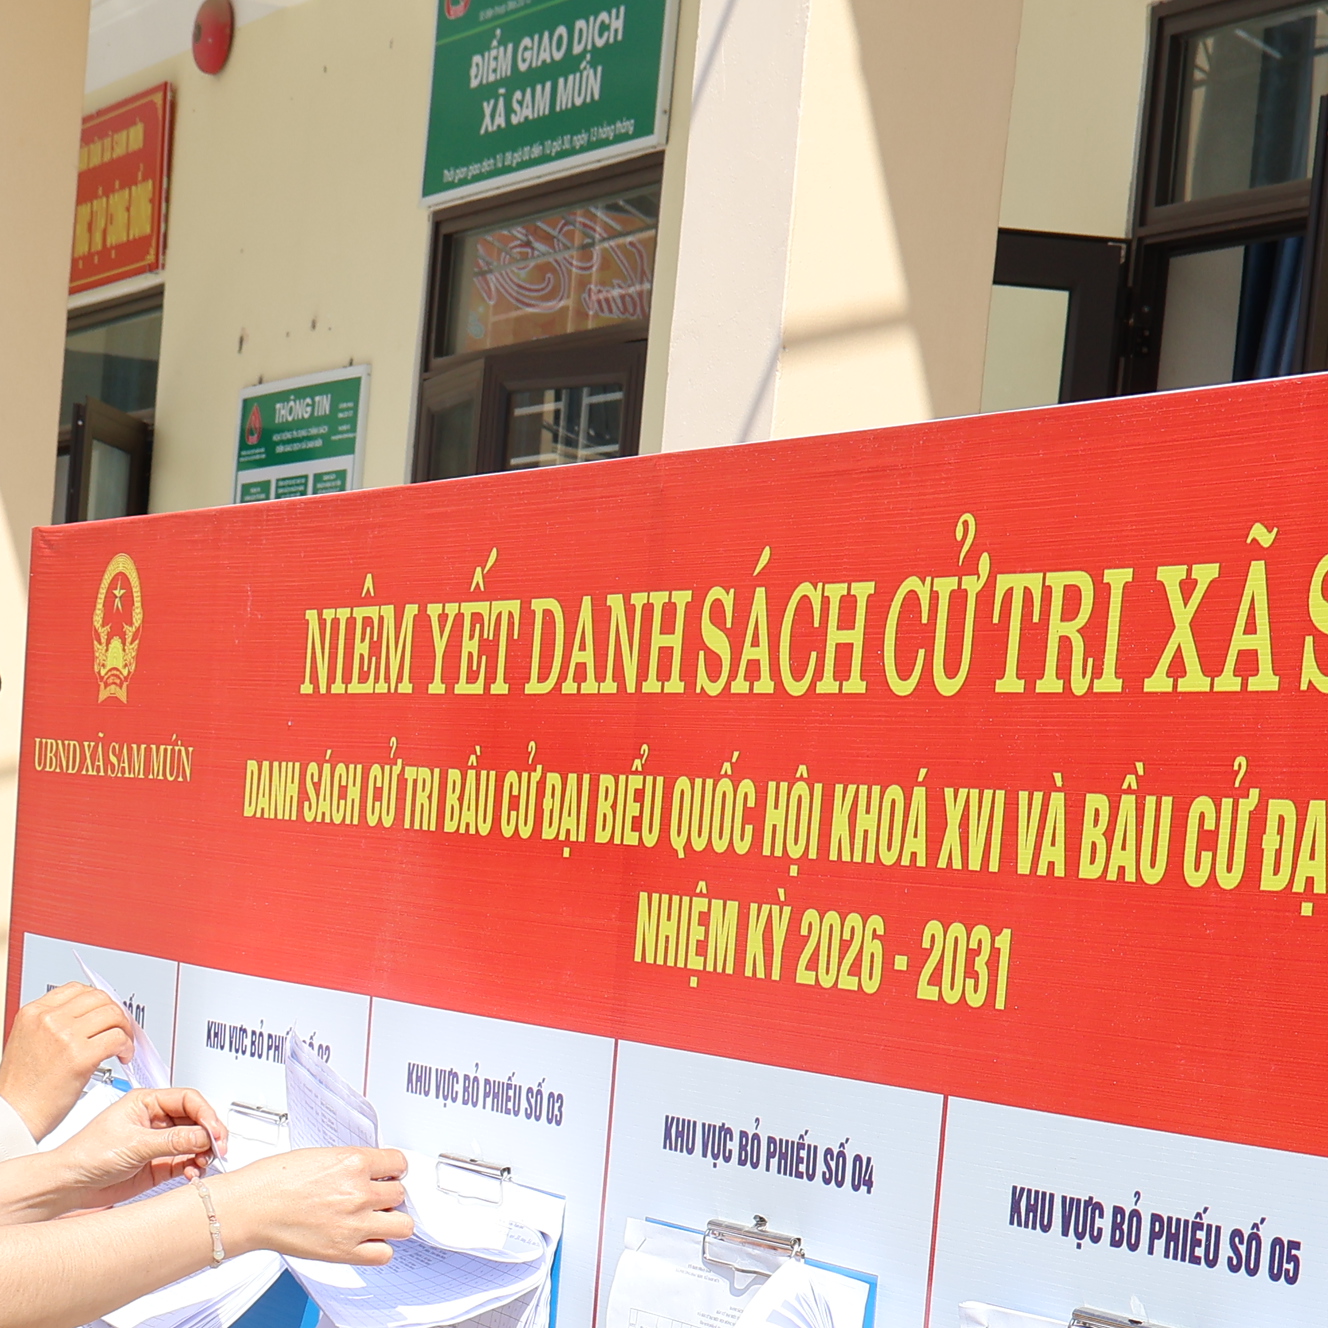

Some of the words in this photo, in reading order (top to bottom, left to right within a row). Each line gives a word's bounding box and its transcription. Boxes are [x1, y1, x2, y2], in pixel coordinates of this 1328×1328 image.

[469, 28, 513, 89] ĐIỂM
[517, 25, 568, 72] GIAO
[572, 5, 625, 60] DỊCH
[480, 88, 506, 135] XÃ
[511, 81, 552, 126] SAM
[275, 395, 312, 424] THÔNG
[314, 393, 332, 417] TIN
[300, 574, 418, 694] NIÊM
[427, 548, 520, 694] YẾT
[525, 590, 692, 694] DANH
[696, 547, 875, 696] SÁCH
[884, 513, 990, 696] CỬ
[993, 568, 1133, 696] TRI
[1144, 523, 1279, 692] XÃ
[35, 738, 80, 773] UBND
[82, 733, 105, 775] XÃ
[108, 743, 147, 778] SAM
[148, 735, 194, 781] MỨN
[244, 760, 300, 820] DANH
[304, 750, 362, 824] SÁCH
[367, 737, 402, 827] CỬ
[404, 766, 440, 831] TRI
[444, 746, 496, 836] BẦU
[501, 741, 542, 839] CỬ
[542, 772, 590, 857] ĐẠI
[595, 745, 664, 847] BIỂU
[670, 752, 755, 858] QUỐC
[763, 765, 822, 876] HỘI
[829, 768, 927, 867] KHOÁ
[937, 788, 1005, 872] XVI
[1018, 773, 1065, 877] VÀ
[1079, 762, 1173, 884] BẦU
[1184, 756, 1259, 890] CỬ
[634, 881, 738, 987] NHIỆM
[745, 888, 791, 980] KỲ
[796, 909, 884, 994] 2026
[917, 920, 1011, 1010] 2031
[206, 1019, 226, 1051] KHU
[228, 1024, 248, 1060] VỰC
[250, 1019, 265, 1060] BỎ
[406, 1061, 432, 1098] KHU
[435, 1066, 459, 1108] VỰC
[462, 1062, 480, 1108] BỎ
[483, 1072, 522, 1118] PHIẾU
[525, 1078, 545, 1122] SỐ
[546, 1092, 564, 1127] 03
[663, 1115, 697, 1155] KHU
[702, 1122, 733, 1168] VỰC
[738, 1118, 761, 1169] BỎ
[766, 1130, 818, 1182] PHIẾU
[822, 1138, 849, 1188] SỐ
[851, 1154, 873, 1194] 04
[1009, 1185, 1055, 1233] KHU
[1061, 1195, 1104, 1249] VỰC
[1110, 1191, 1142, 1252] BỎ
[1148, 1207, 1221, 1268] PHIẾU
[1227, 1217, 1266, 1277] SỐ
[1268, 1237, 1301, 1285] 05
